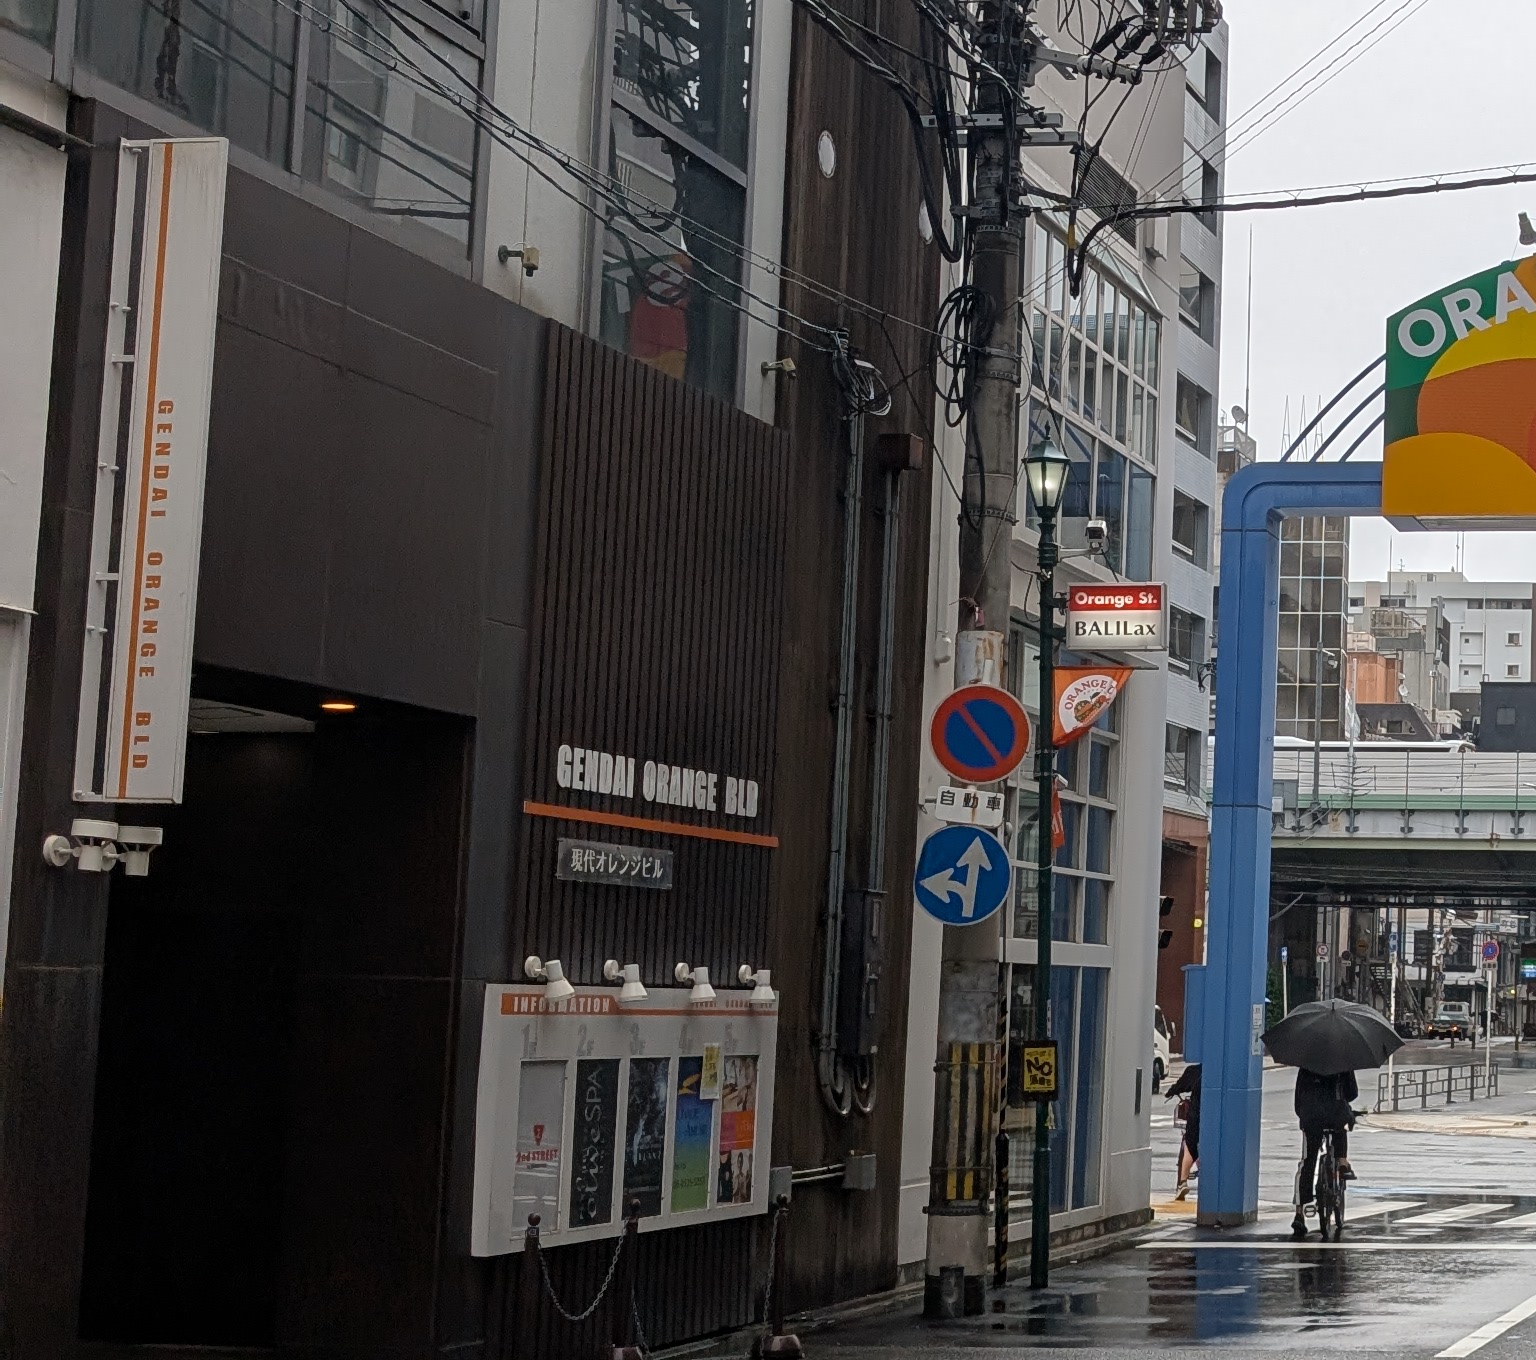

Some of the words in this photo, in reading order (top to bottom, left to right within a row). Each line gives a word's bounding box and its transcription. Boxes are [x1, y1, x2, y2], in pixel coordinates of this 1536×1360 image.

[150, 399, 175, 518] GENDAI
[138, 551, 164, 678] ORANGE
[1075, 592, 1134, 608] Orange
[1139, 592, 1158, 605] St.
[1064, 679, 1107, 711] ORANGE
[132, 712, 150, 771] BLD
[557, 745, 635, 798] GENDAI
[643, 761, 718, 811] ORANGE
[725, 777, 759, 817] BLD
[941, 790, 1001, 811] 自動車
[571, 848, 663, 878] 現代オレンジビル
[514, 996, 610, 1013] INFORMATION
